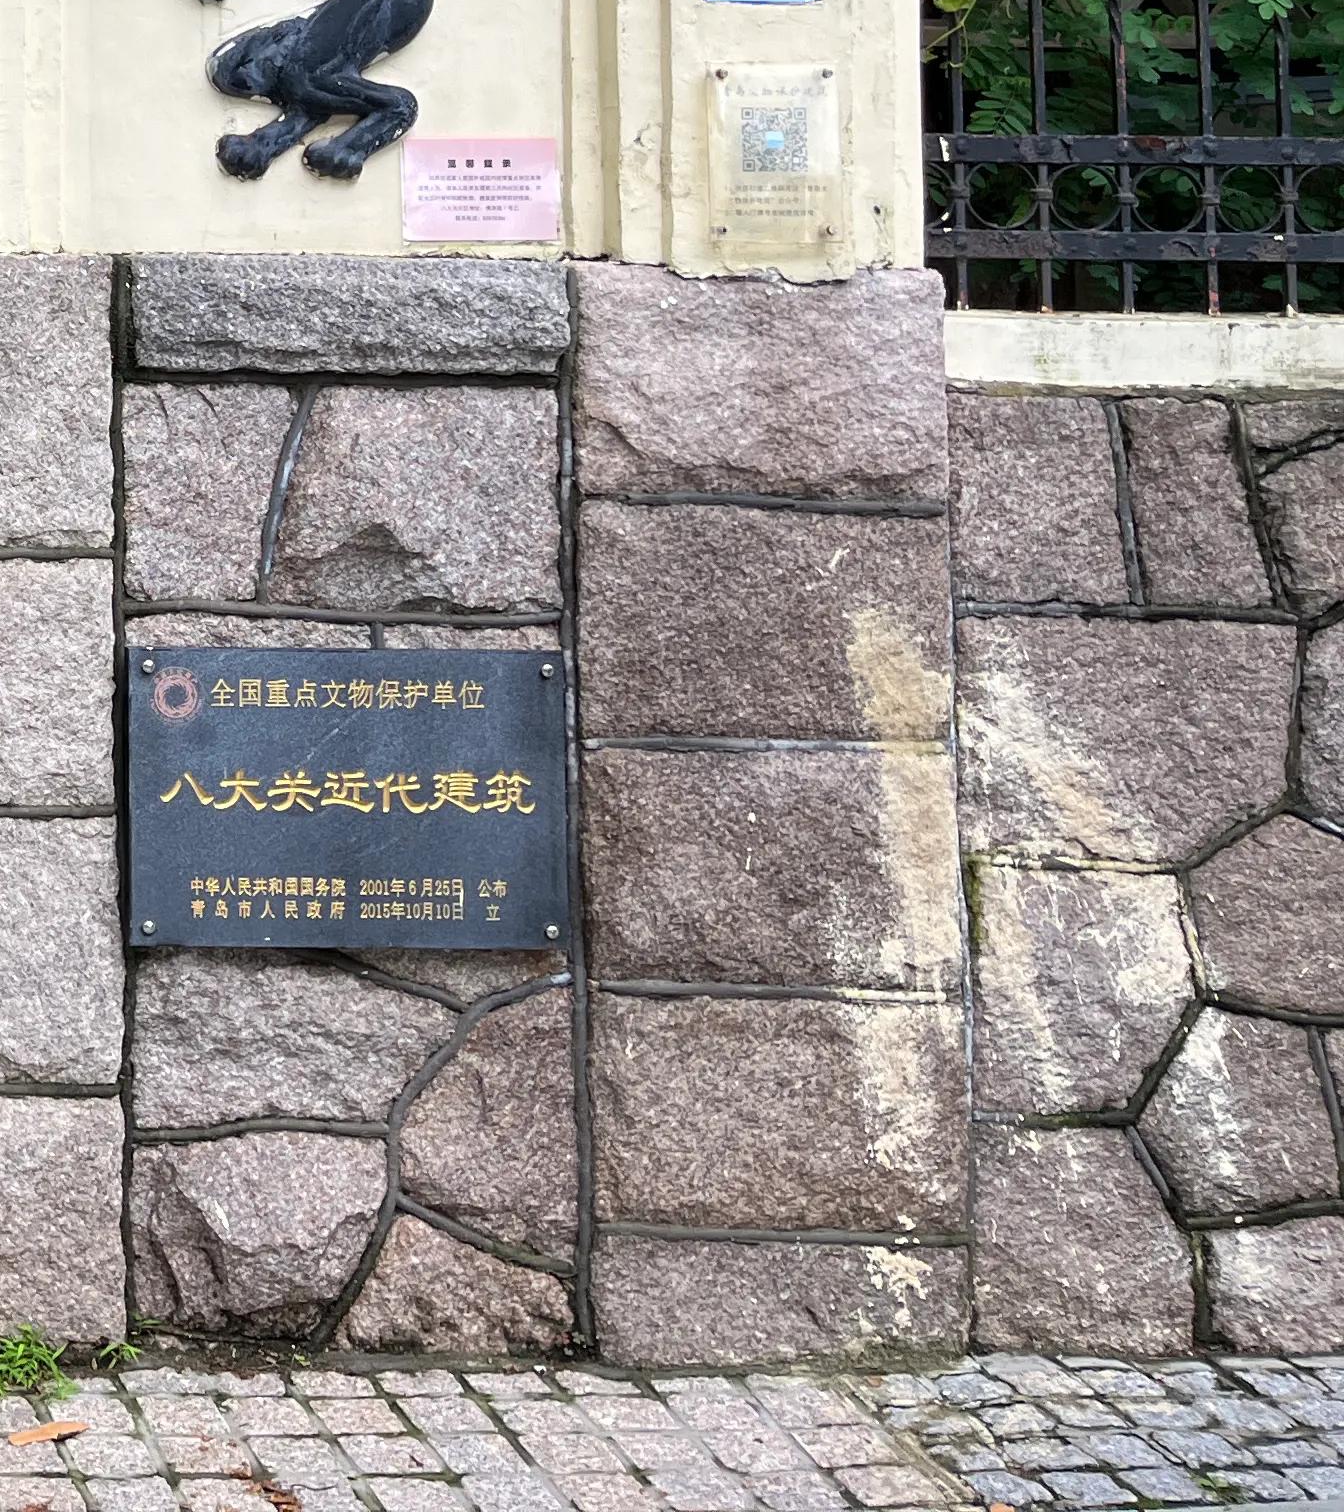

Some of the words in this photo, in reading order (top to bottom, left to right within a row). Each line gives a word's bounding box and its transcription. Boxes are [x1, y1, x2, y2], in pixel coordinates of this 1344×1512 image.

[210, 678, 486, 710] 全国重点文物保护单位
[159, 768, 536, 814] 八大关近代建筑
[190, 876, 346, 897] 中华人民共和国国务院
[477, 879, 508, 899] 公布
[190, 899, 346, 921] 青岛市人民政府
[359, 899, 464, 921] 2015年10月10日
[485, 903, 501, 922] 立
